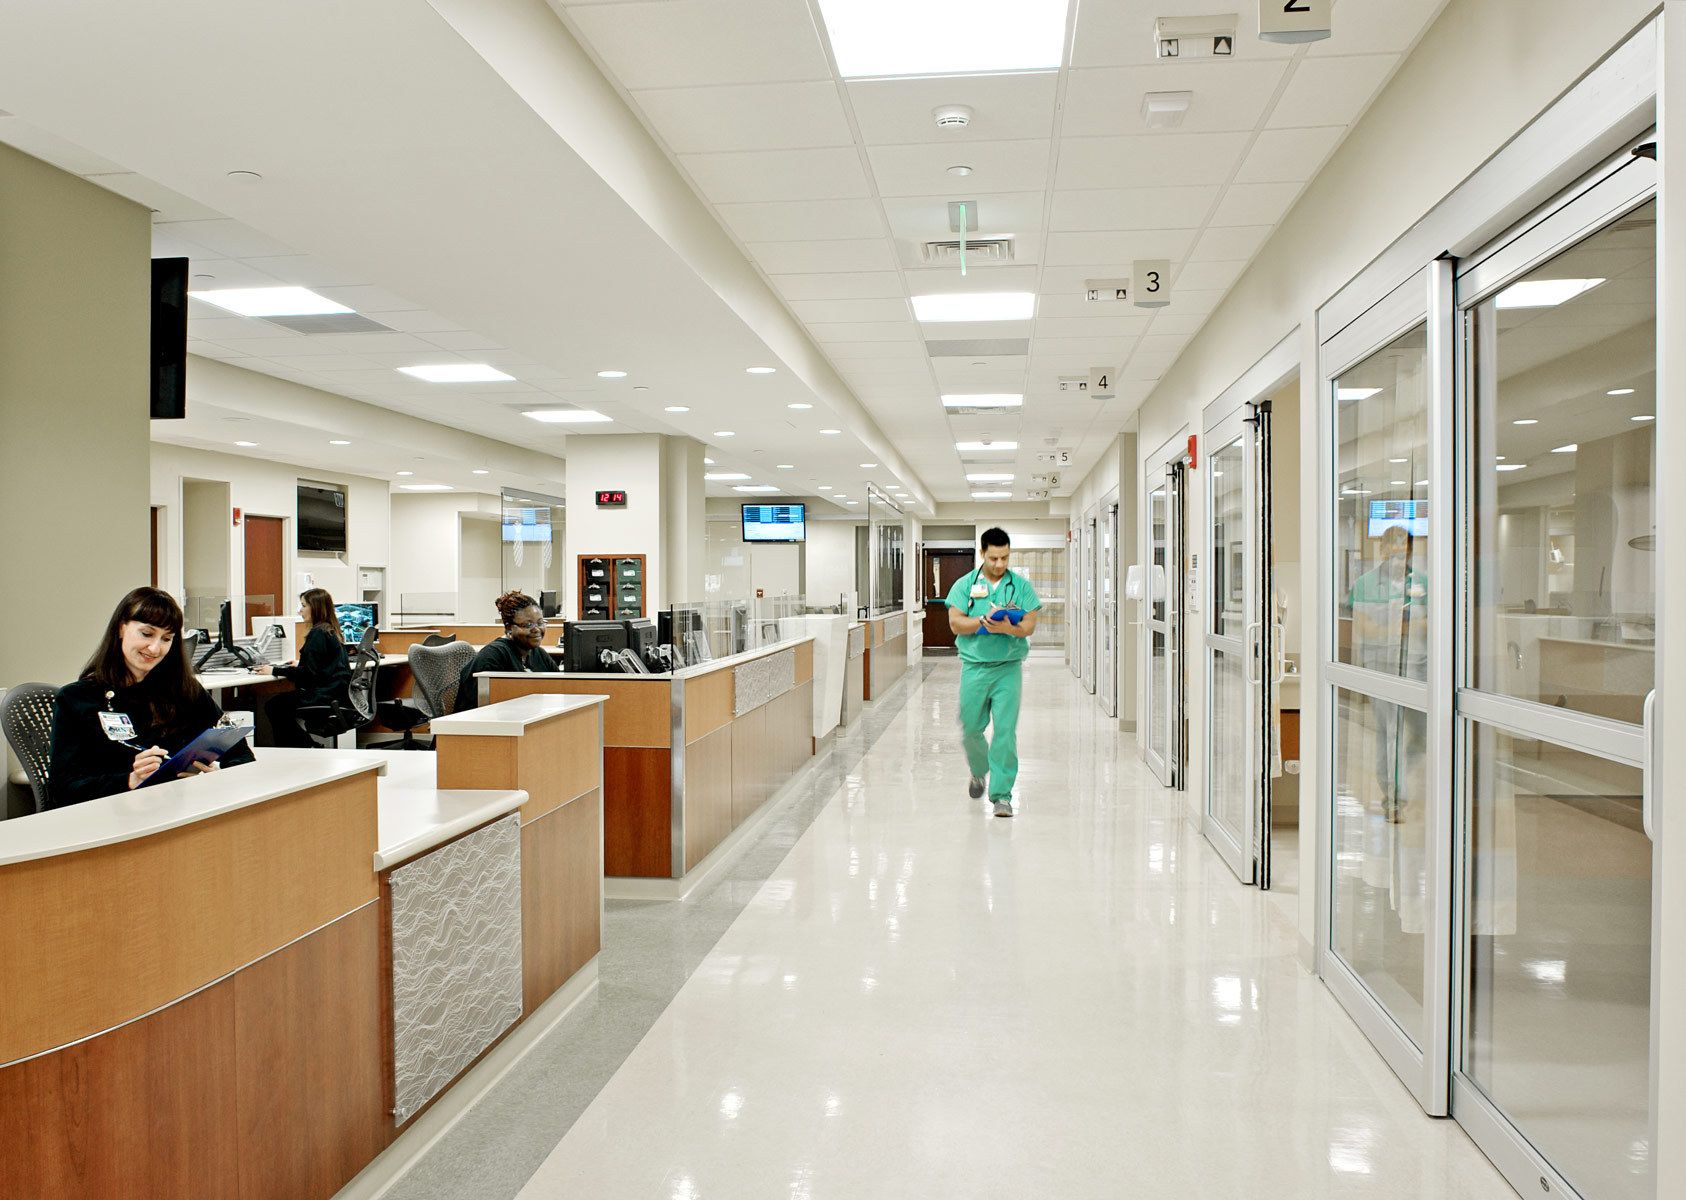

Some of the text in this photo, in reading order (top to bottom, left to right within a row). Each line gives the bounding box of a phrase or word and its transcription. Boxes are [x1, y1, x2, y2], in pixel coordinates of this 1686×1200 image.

[1146, 271, 1160, 292] 3
[1098, 375, 1108, 389] 4
[1061, 452, 1068, 461] 5
[1051, 476, 1057, 484] 6
[600, 493, 623, 502] 12 14
